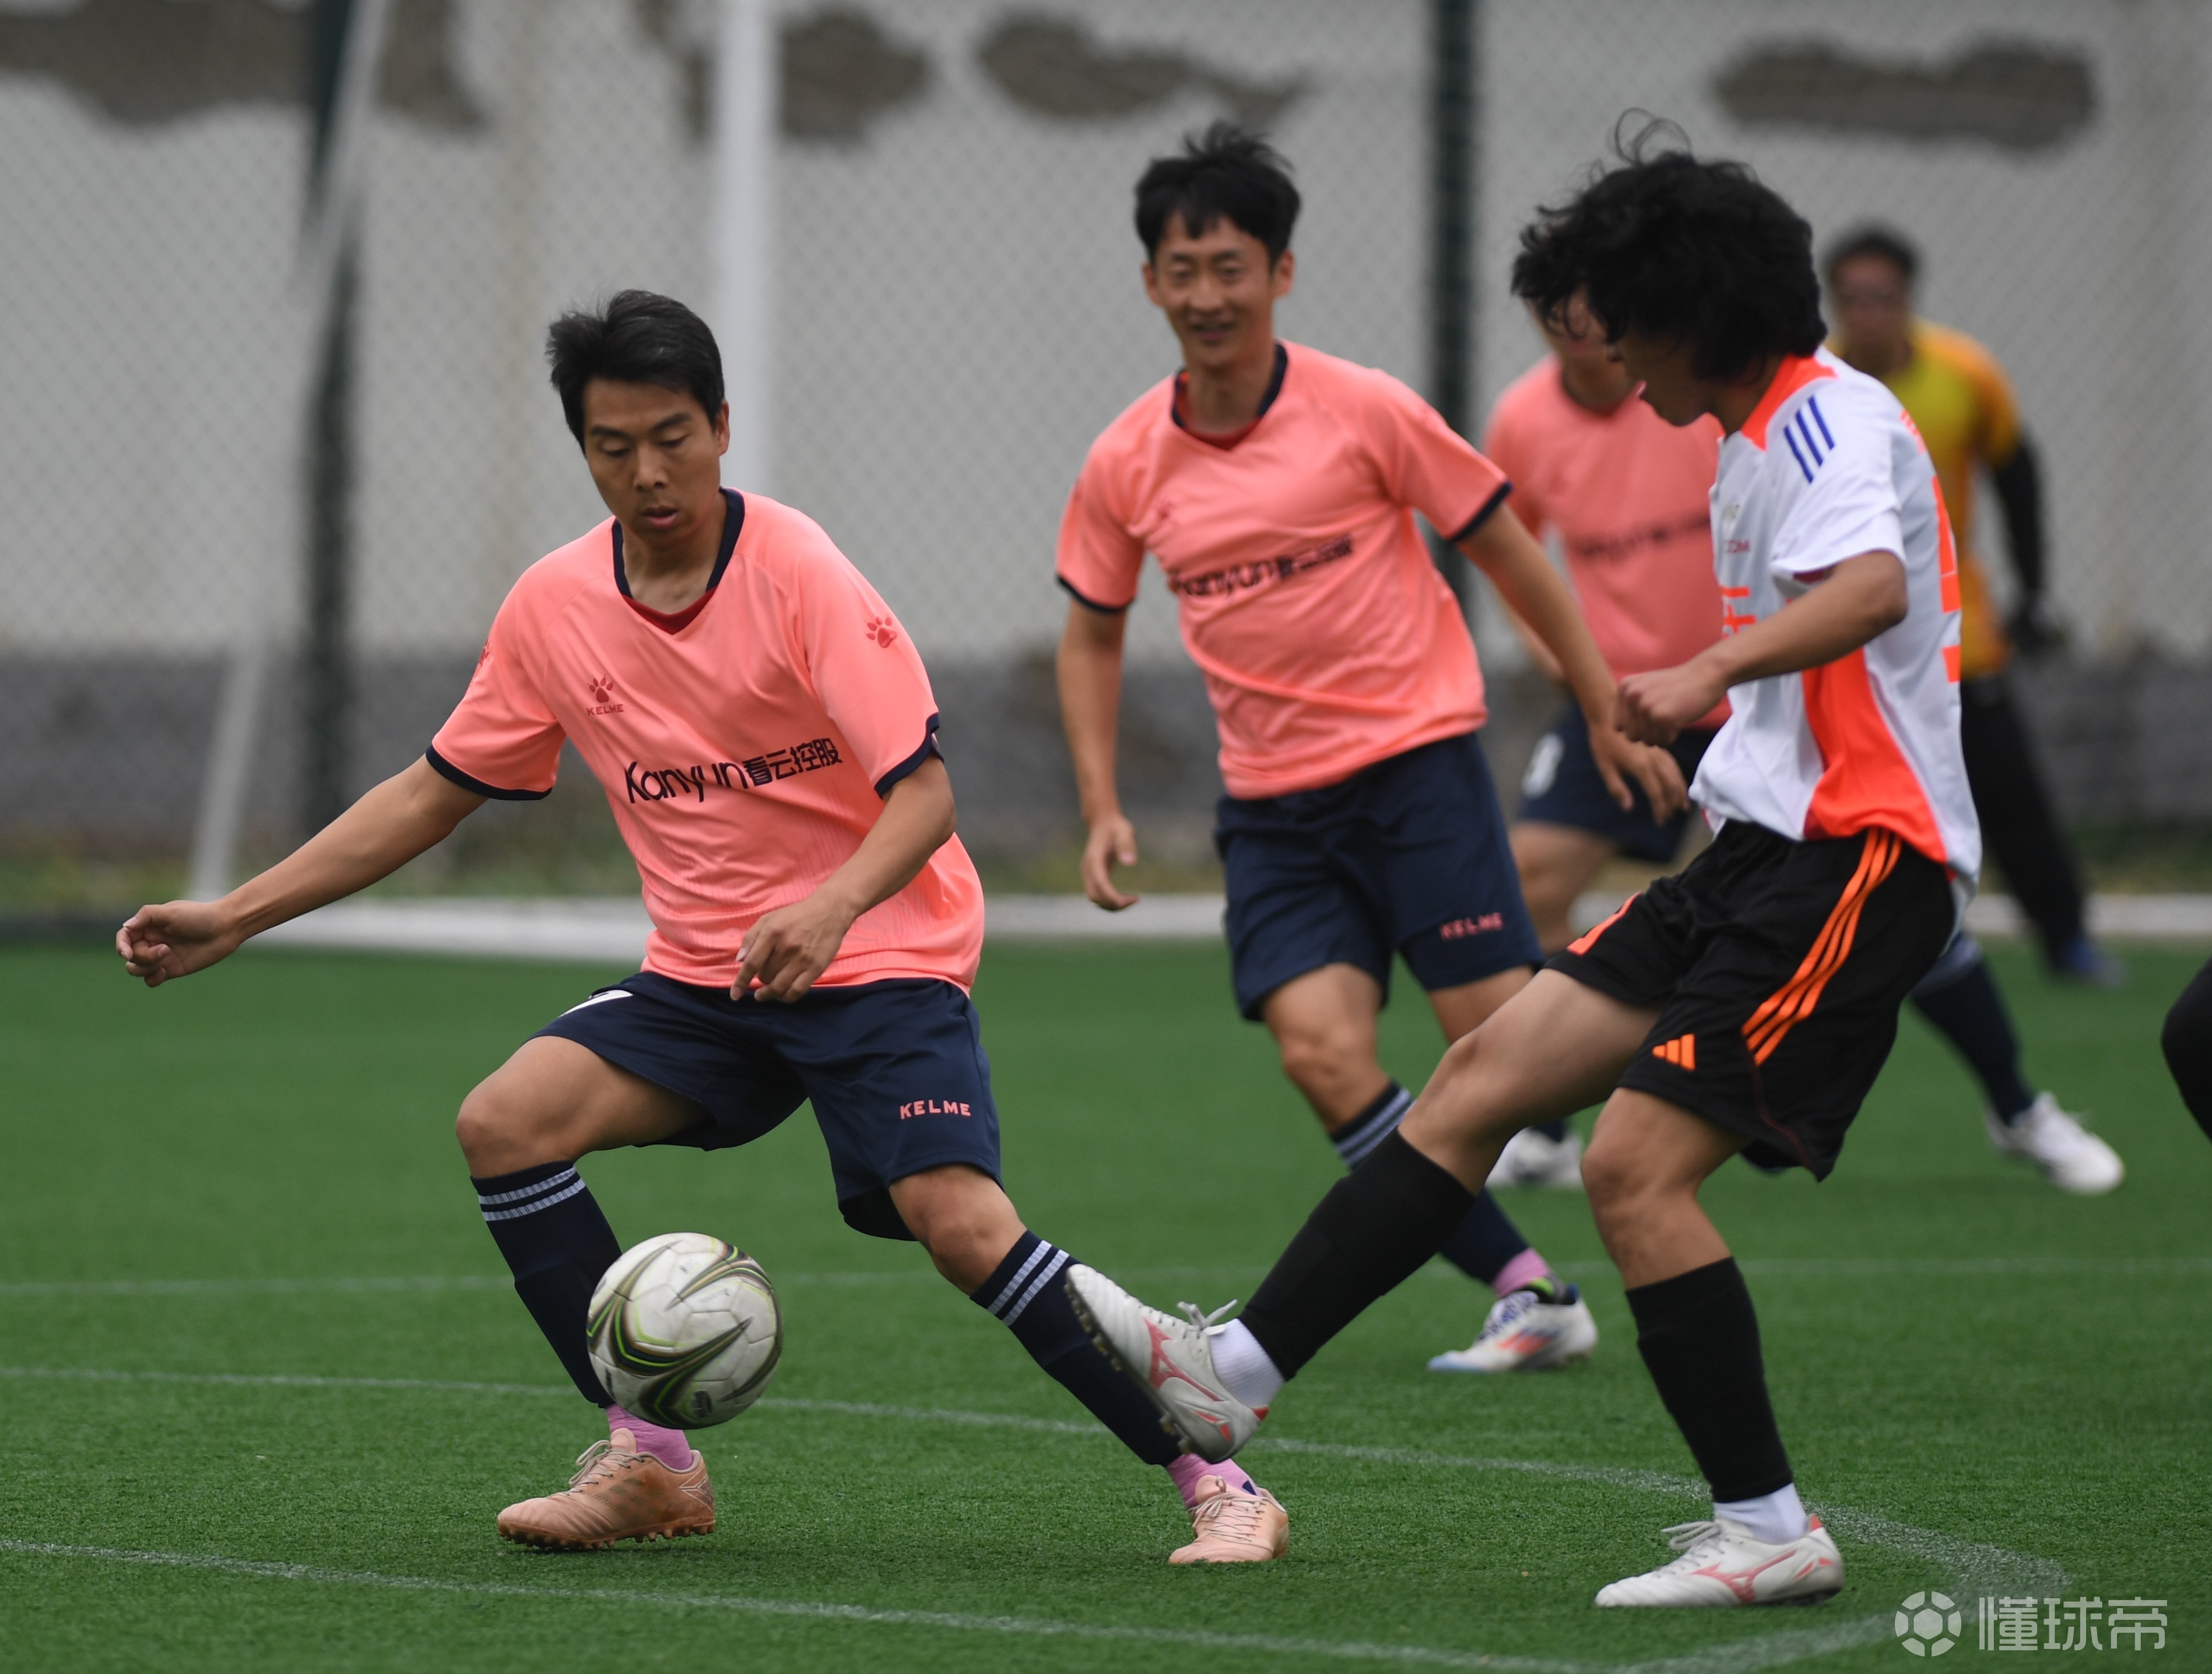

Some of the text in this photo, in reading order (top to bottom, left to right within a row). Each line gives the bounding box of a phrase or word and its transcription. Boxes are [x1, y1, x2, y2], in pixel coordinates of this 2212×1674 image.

[587, 704, 624, 716] KELME
[626, 737, 842, 803] Kanyun 看云控股
[900, 1099, 971, 1119] KELME
